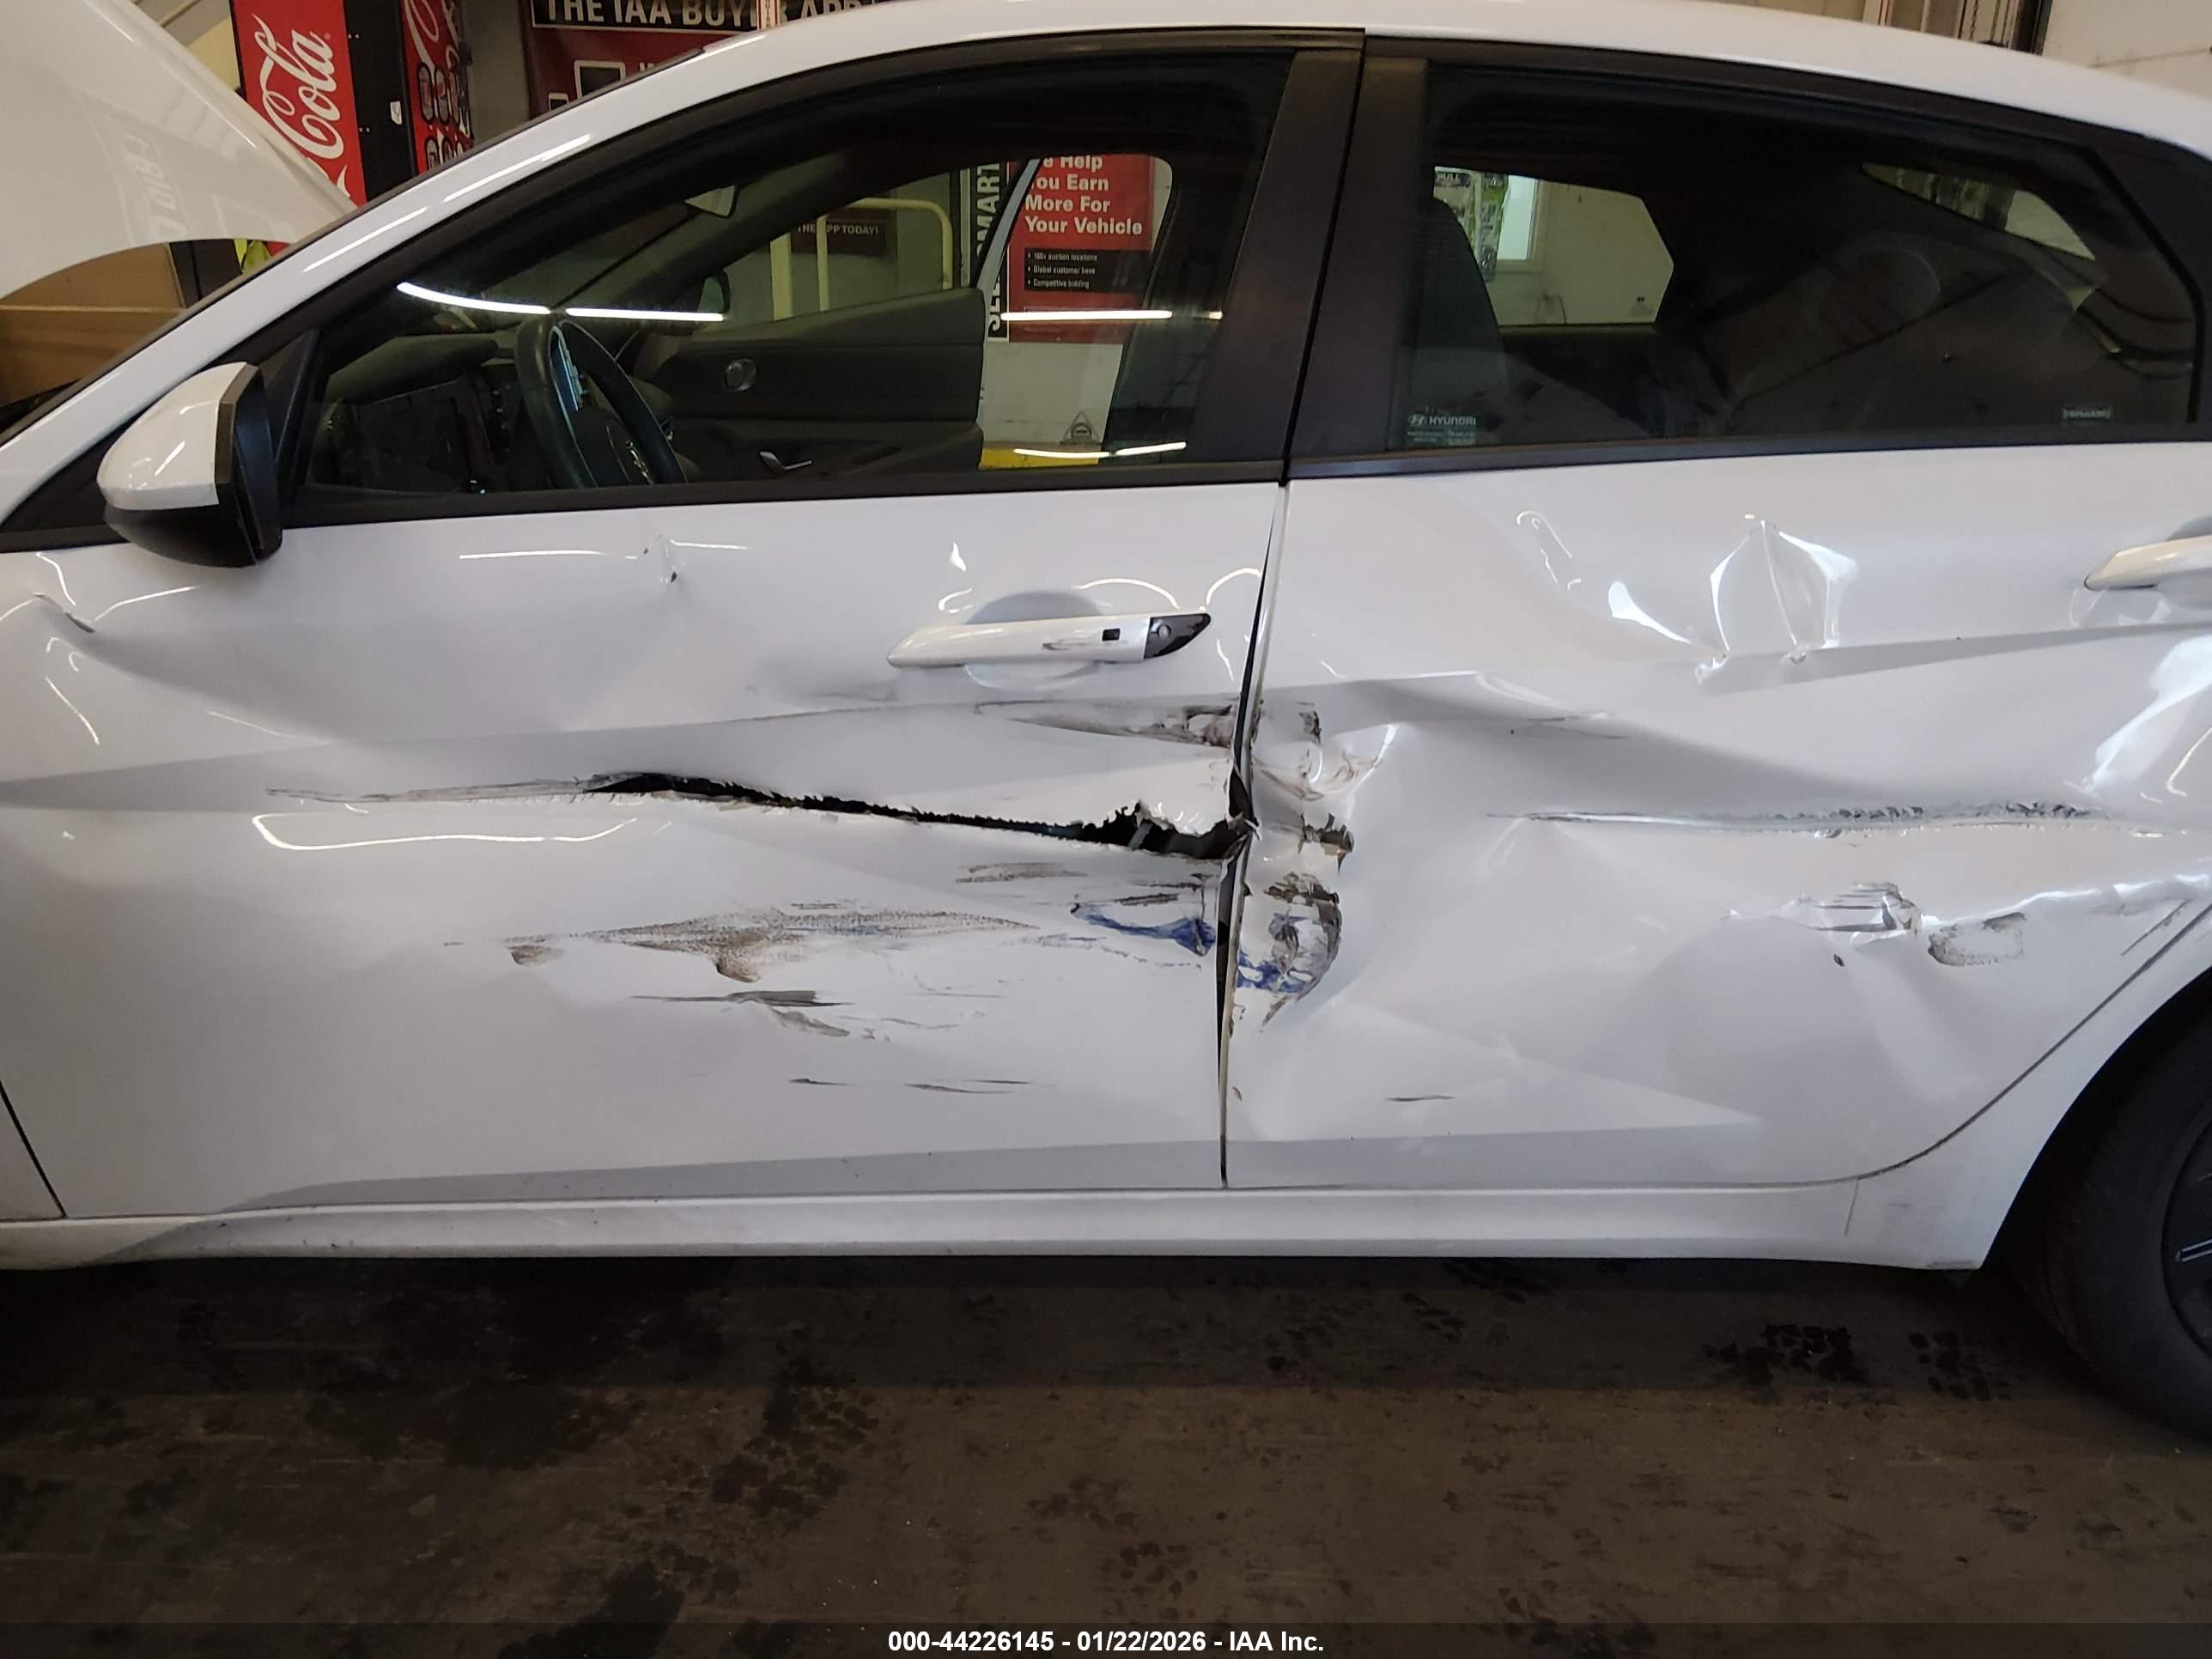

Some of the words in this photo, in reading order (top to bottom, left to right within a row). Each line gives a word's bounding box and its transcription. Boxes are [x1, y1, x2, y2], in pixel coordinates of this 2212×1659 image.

[1060, 155, 1103, 172] Help
[1031, 176, 1060, 191] ou
[1066, 173, 1109, 191] Earn
[1024, 194, 1073, 212] More
[1080, 195, 1111, 213] For
[1024, 216, 1068, 233] Your
[1073, 216, 1143, 235] Vehicle
